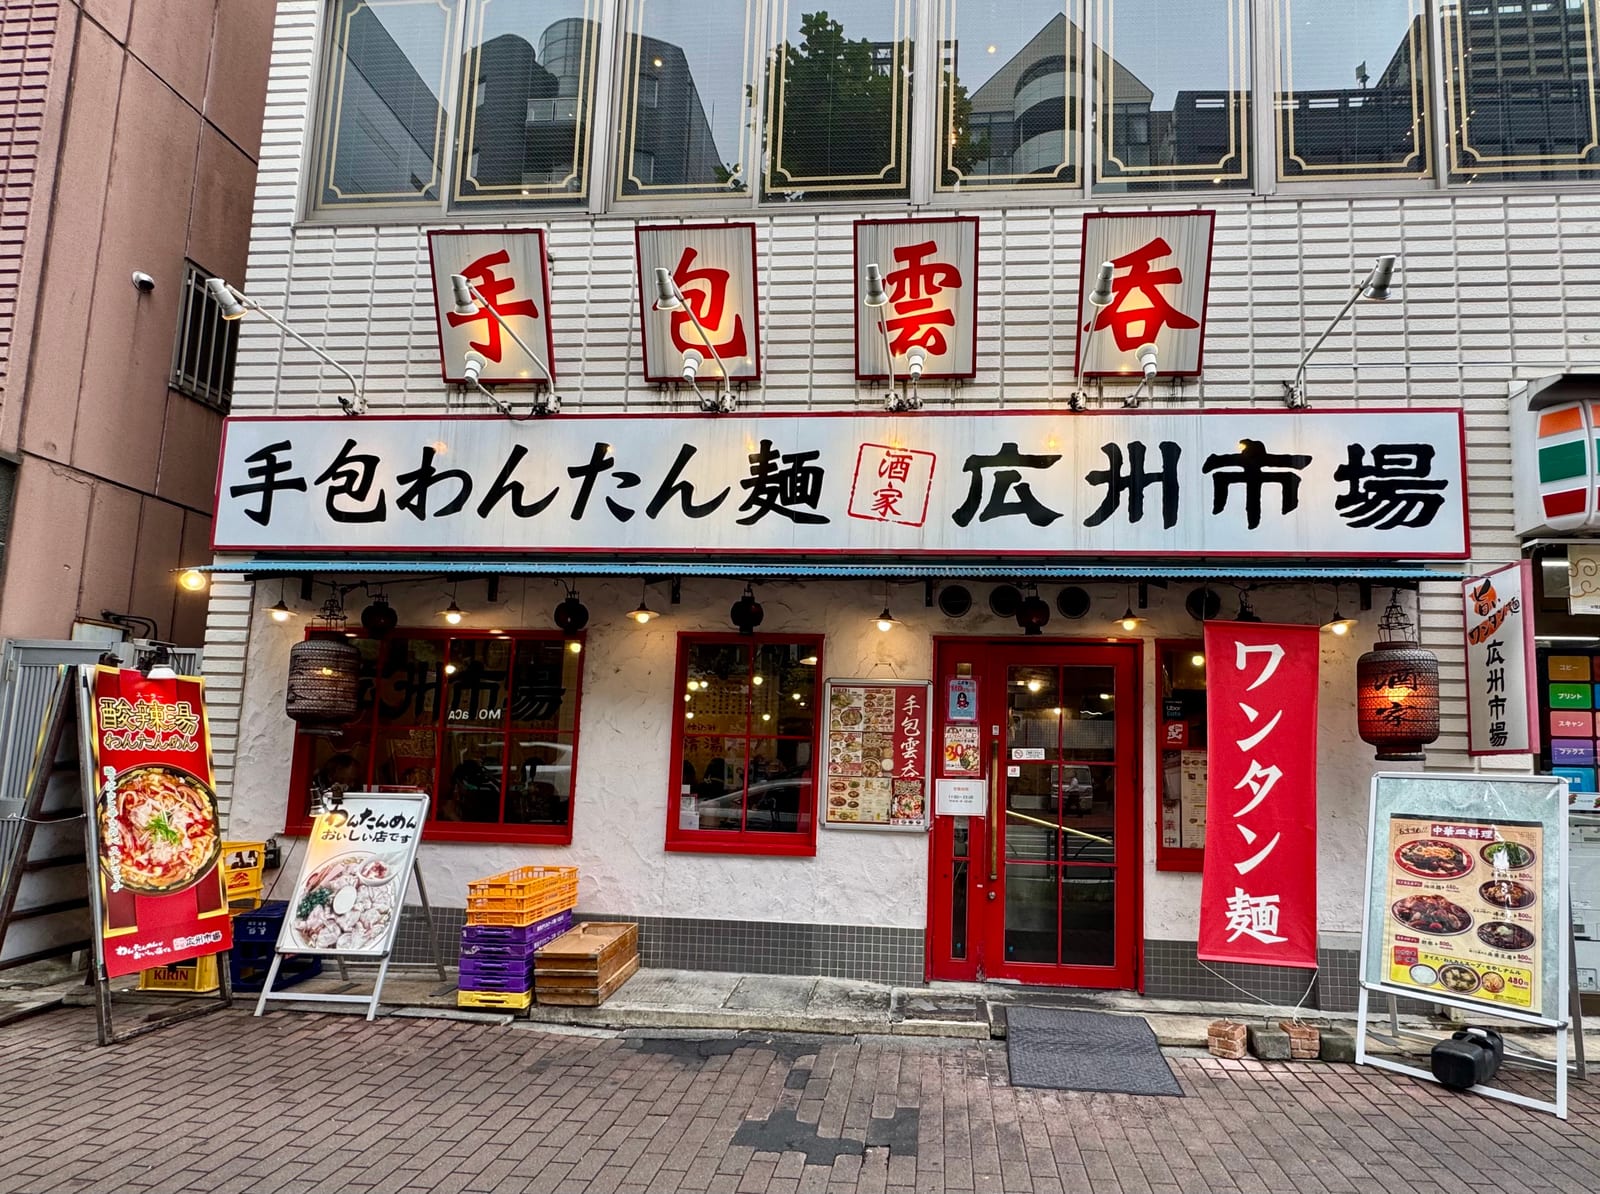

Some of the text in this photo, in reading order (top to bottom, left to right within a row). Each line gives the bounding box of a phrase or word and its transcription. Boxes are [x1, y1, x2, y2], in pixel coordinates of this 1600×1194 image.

[446, 249, 539, 364] 手
[652, 247, 748, 360] 包
[878, 240, 962, 356] 雲
[229, 438, 832, 527] 手包わんたん麺
[870, 447, 914, 519] 酒家
[951, 439, 1450, 530] 広州市場
[1486, 639, 1509, 747] 広州市場
[1557, 692, 1583, 701] プリント
[100, 698, 199, 736] 酸辣湯
[1558, 720, 1584, 728] スキャン
[105, 733, 198, 751] わんたんめん
[1558, 747, 1585, 756] ファクス
[1224, 640, 1289, 945] ワンタン麺
[325, 807, 417, 831] わんたんめん
[321, 829, 412, 844] おいしい店です
[1433, 825, 1494, 840] 中華皿料理
[154, 969, 189, 981] KIRIN
